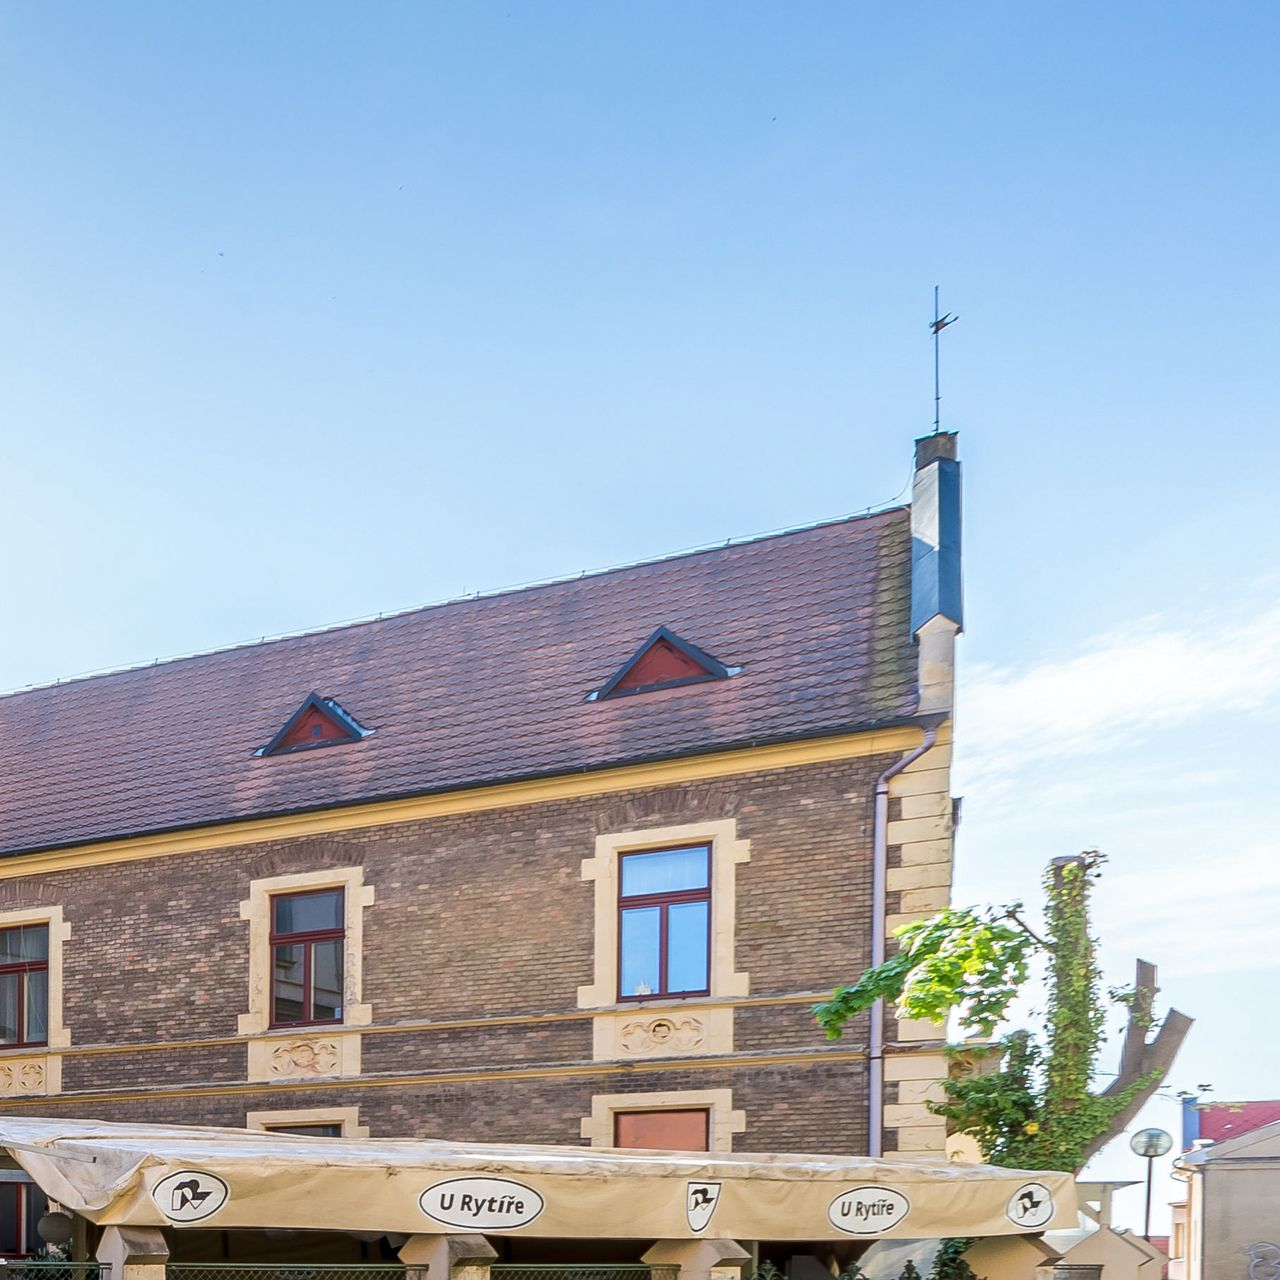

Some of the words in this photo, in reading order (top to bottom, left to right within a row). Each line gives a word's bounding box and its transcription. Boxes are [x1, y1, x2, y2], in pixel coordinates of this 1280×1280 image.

[440, 1193, 455, 1211] U
[460, 1194, 524, 1217] Rytíře
[841, 1201, 852, 1217] U
[855, 1199, 895, 1221] Rytíře
